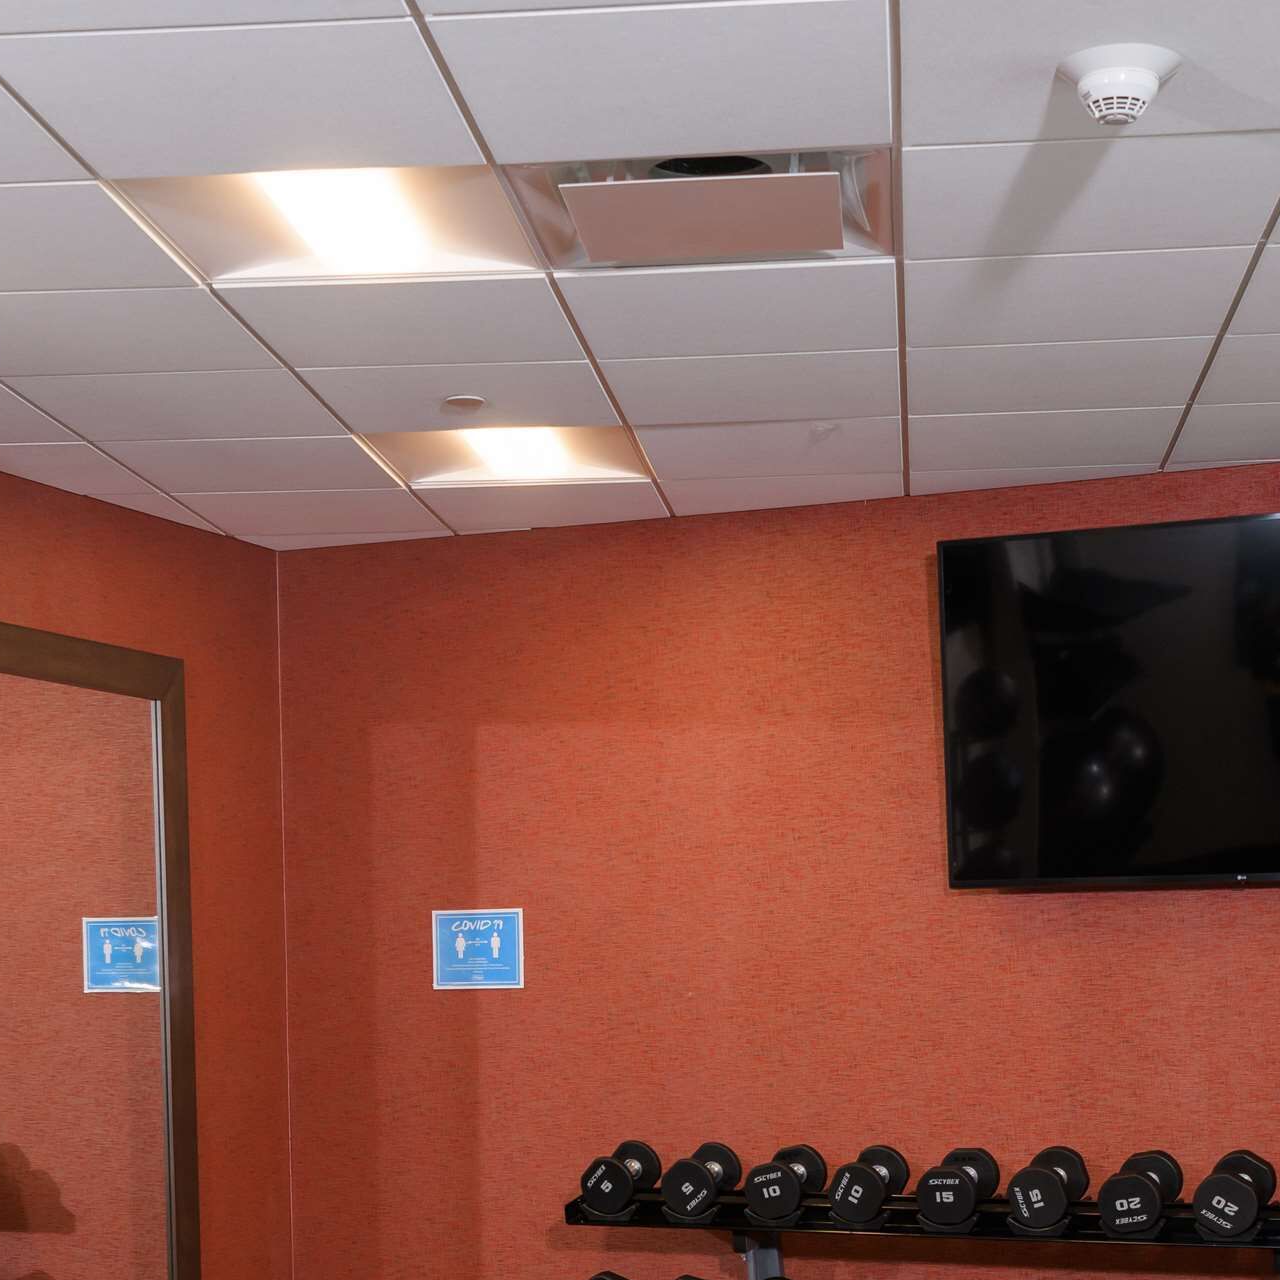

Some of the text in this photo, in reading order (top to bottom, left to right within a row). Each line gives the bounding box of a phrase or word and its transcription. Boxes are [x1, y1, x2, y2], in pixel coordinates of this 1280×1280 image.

[451, 921, 491, 931] COVID
[600, 1180, 613, 1193] 5
[681, 1182, 694, 1195] 5
[763, 1185, 781, 1199] 10
[847, 1185, 864, 1205] 10
[935, 1191, 954, 1202] 15
[1028, 1188, 1045, 1208] 15
[1115, 1197, 1142, 1211] 20
[1212, 1195, 1239, 1216] 20
[1114, 1216, 1138, 1225] CYBEX
